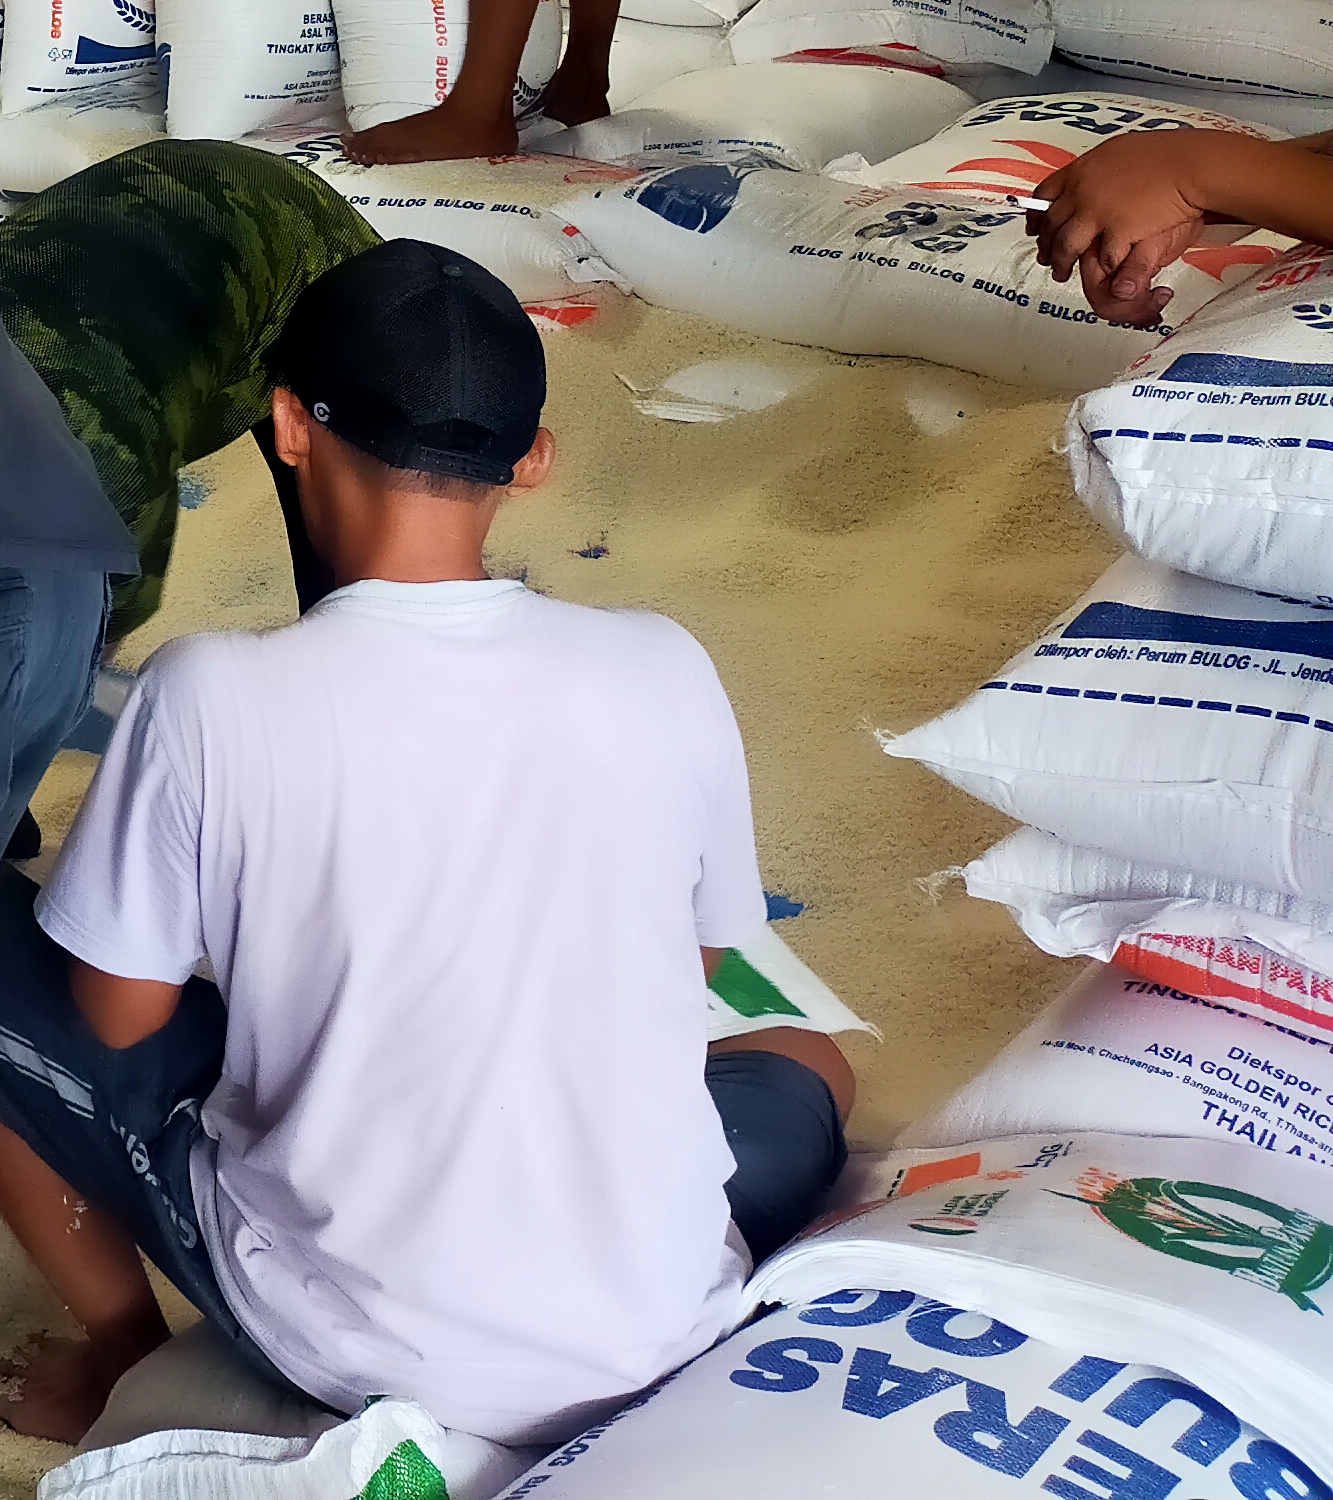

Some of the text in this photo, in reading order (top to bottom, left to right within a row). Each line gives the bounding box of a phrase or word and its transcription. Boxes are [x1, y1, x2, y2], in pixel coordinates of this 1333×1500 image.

[300, 27, 322, 38] ASAL
[266, 43, 315, 54] TINGKAT
[377, 197, 486, 211] BULOG BULOG
[907, 261, 966, 284] BULOG
[972, 278, 1030, 307] BULOG
[1037, 300, 1099, 326] BULOG
[1131, 384, 1193, 403] Diimpor
[1196, 389, 1237, 406] oleh:
[1239, 391, 1292, 407] Perum
[1033, 642, 1093, 661] Diimpor
[1094, 645, 1133, 662] oleh:
[1135, 646, 1187, 665] Perum
[1188, 649, 1250, 670] BULOG
[1144, 1042, 1291, 1109] ASIA GOLDEN
[1227, 1046, 1322, 1097] Diekspor
[1182, 1074, 1251, 1113] Bangpakong
